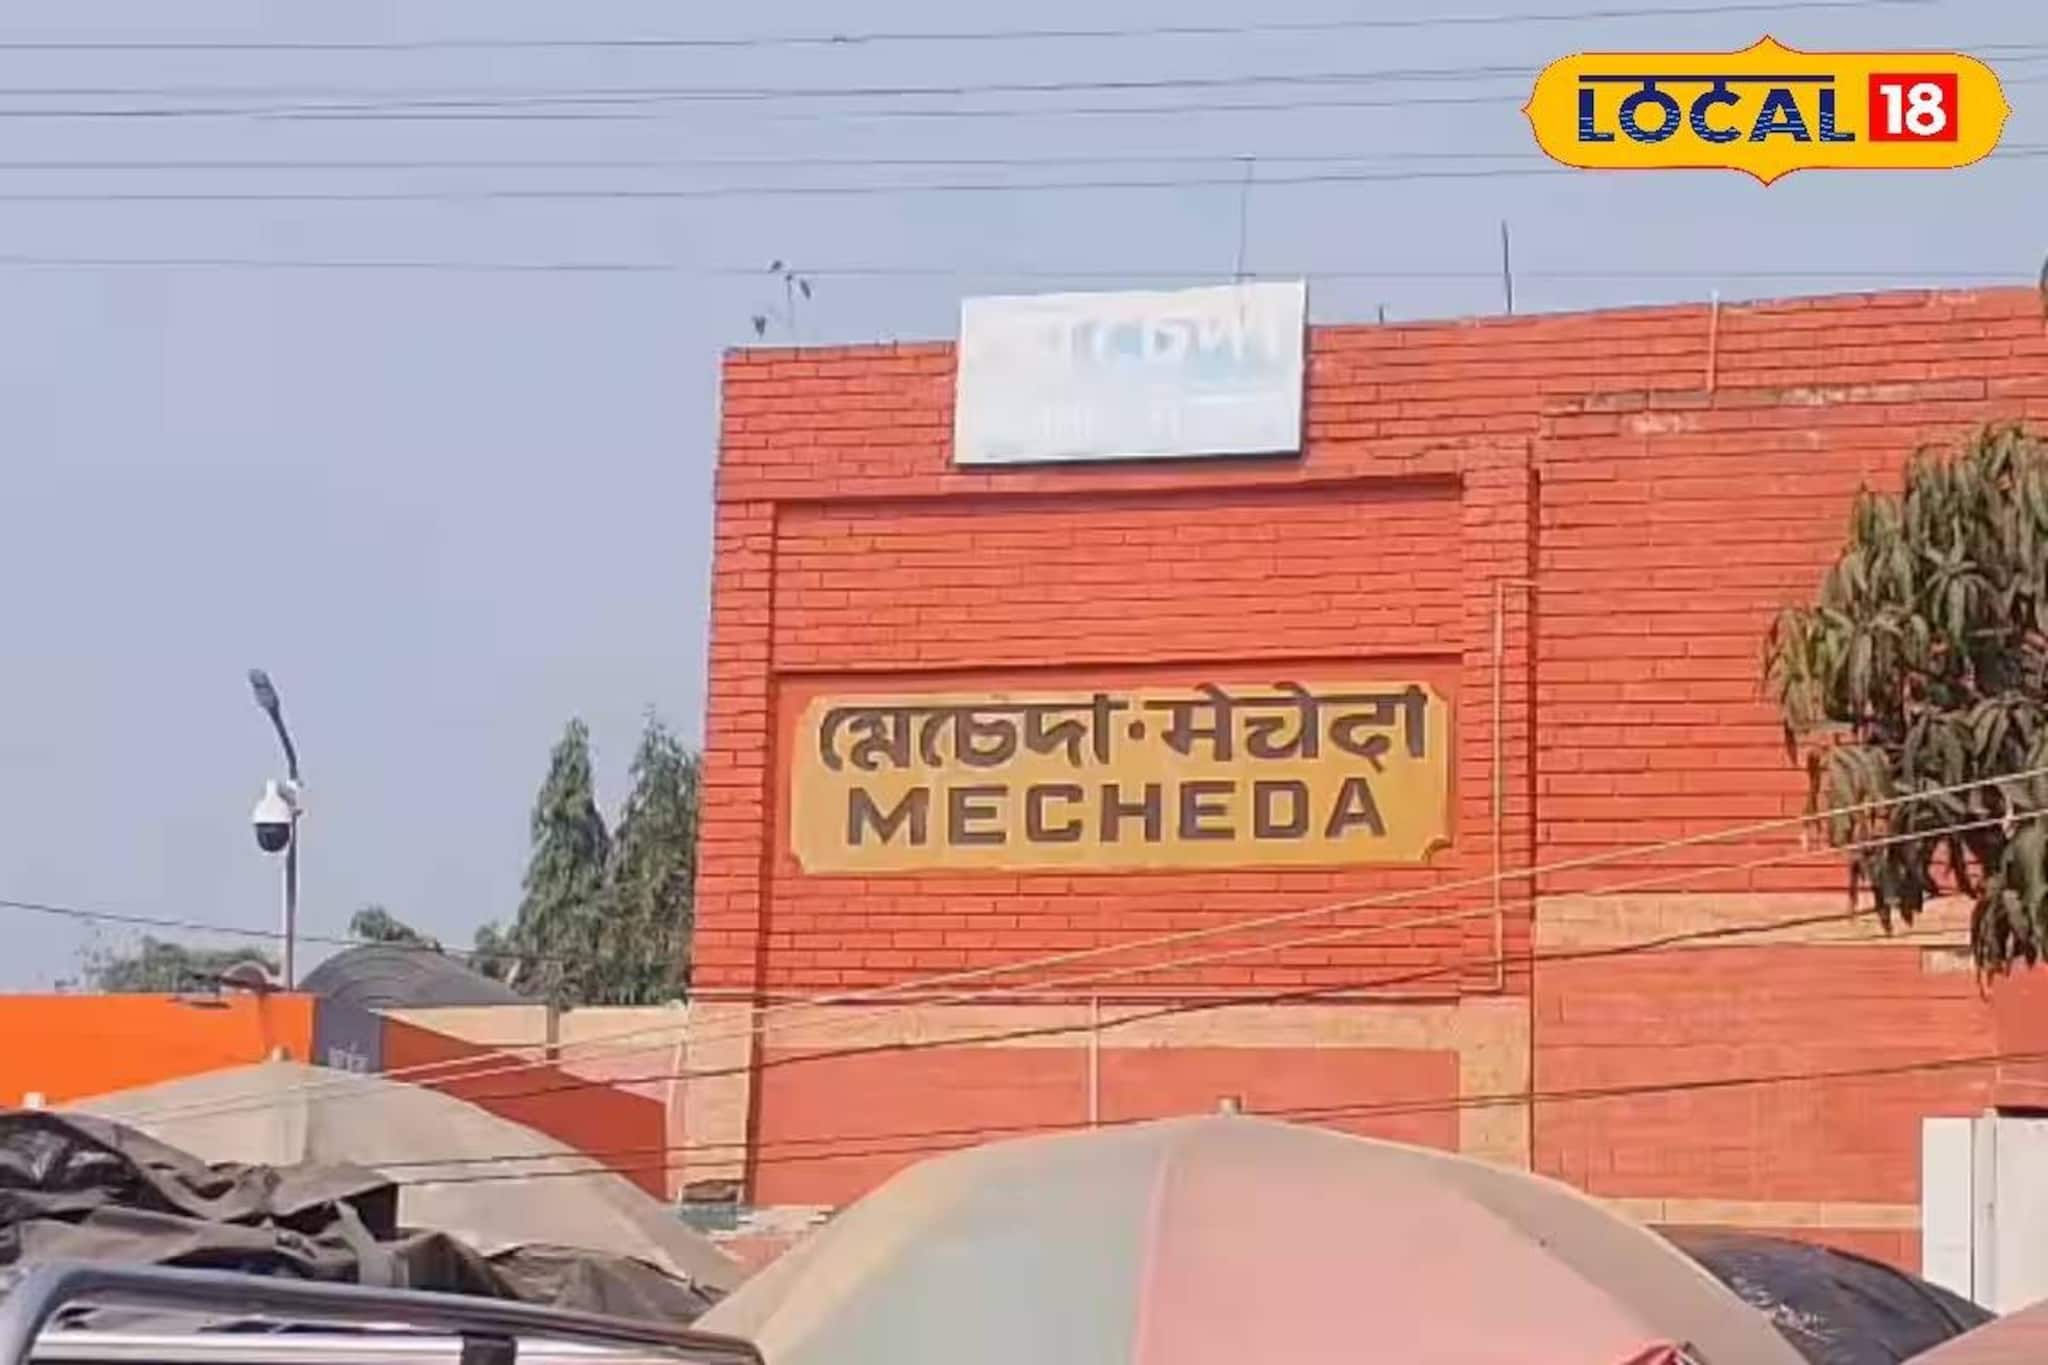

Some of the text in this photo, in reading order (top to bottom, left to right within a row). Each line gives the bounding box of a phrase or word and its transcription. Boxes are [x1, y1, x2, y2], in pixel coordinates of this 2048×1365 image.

[820, 694, 1128, 771] মেচেদা
[1144, 682, 1428, 773] मेचेदा
[847, 777, 1386, 845] MECHEDA
